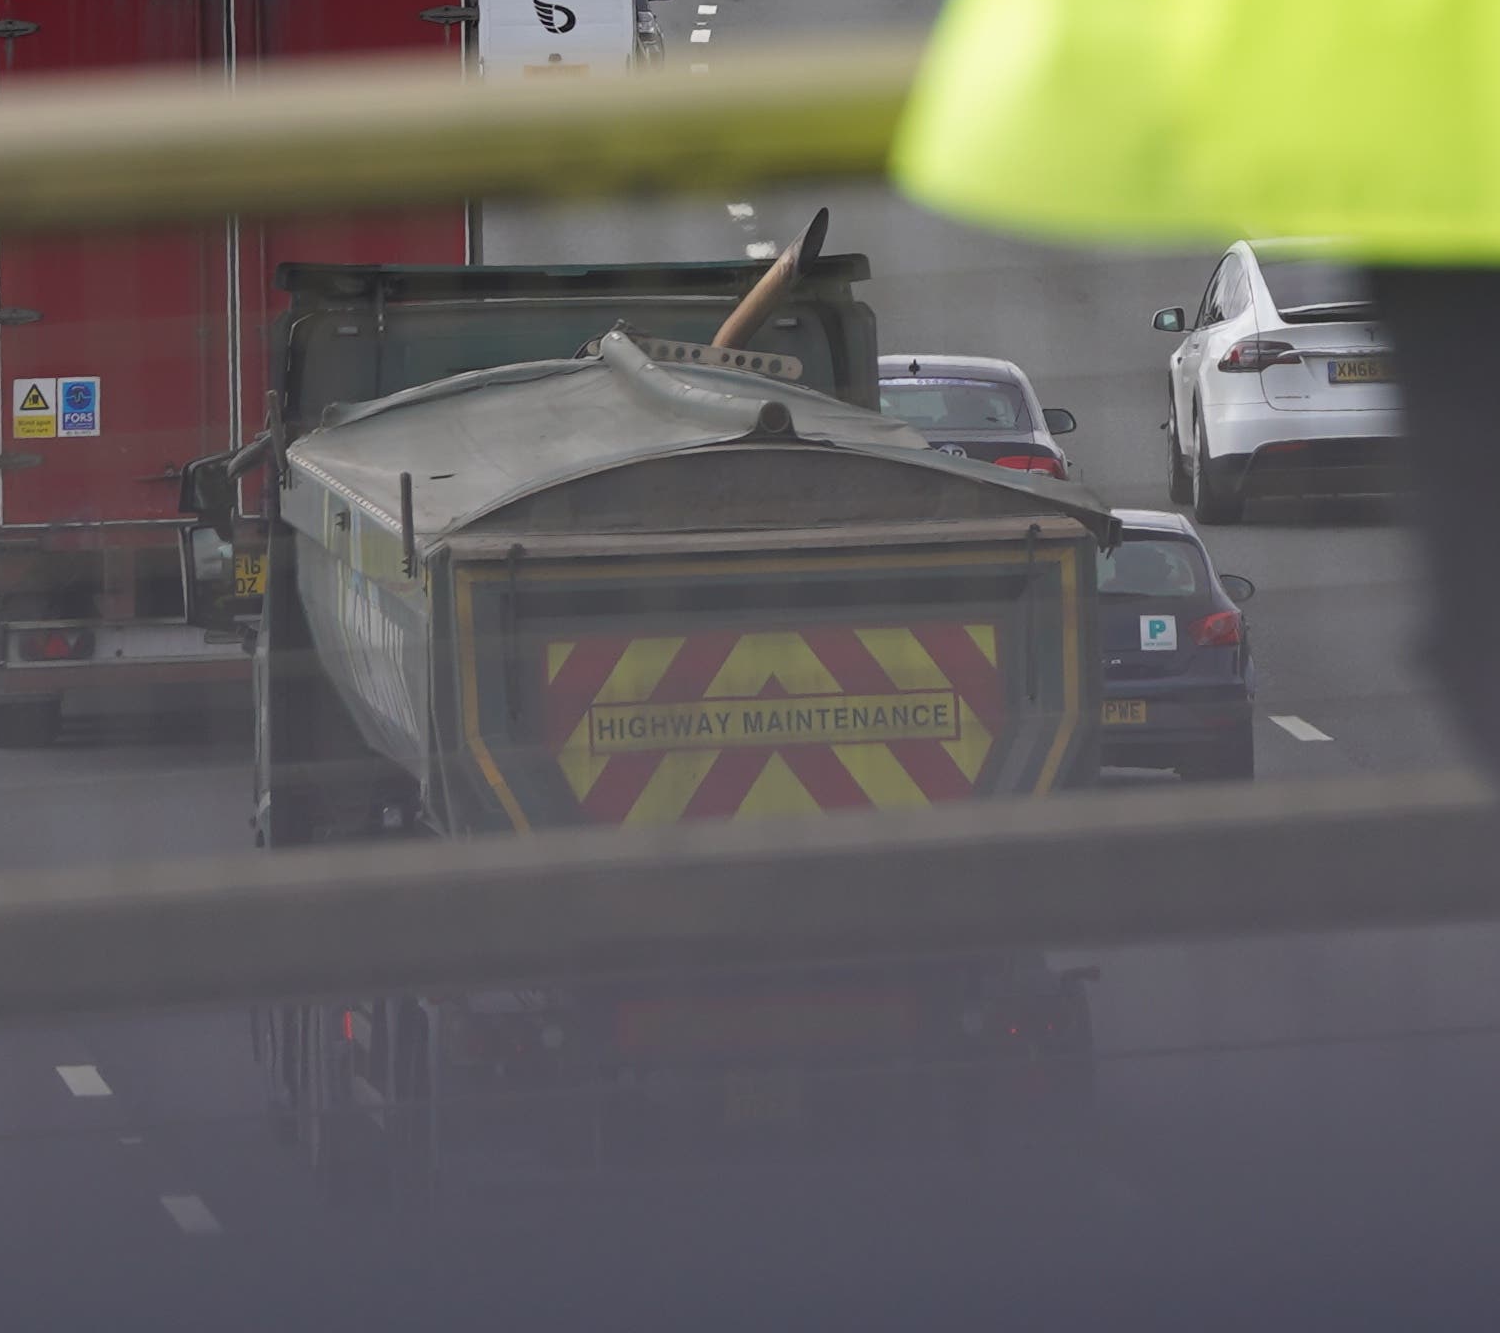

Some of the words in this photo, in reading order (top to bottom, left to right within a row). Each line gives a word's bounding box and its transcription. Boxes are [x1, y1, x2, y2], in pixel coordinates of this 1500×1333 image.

[64, 412, 94, 424] FORS
[1148, 619, 1167, 640] P
[598, 712, 732, 741] HIGHWAY
[742, 703, 949, 734] MAINTENANCE
